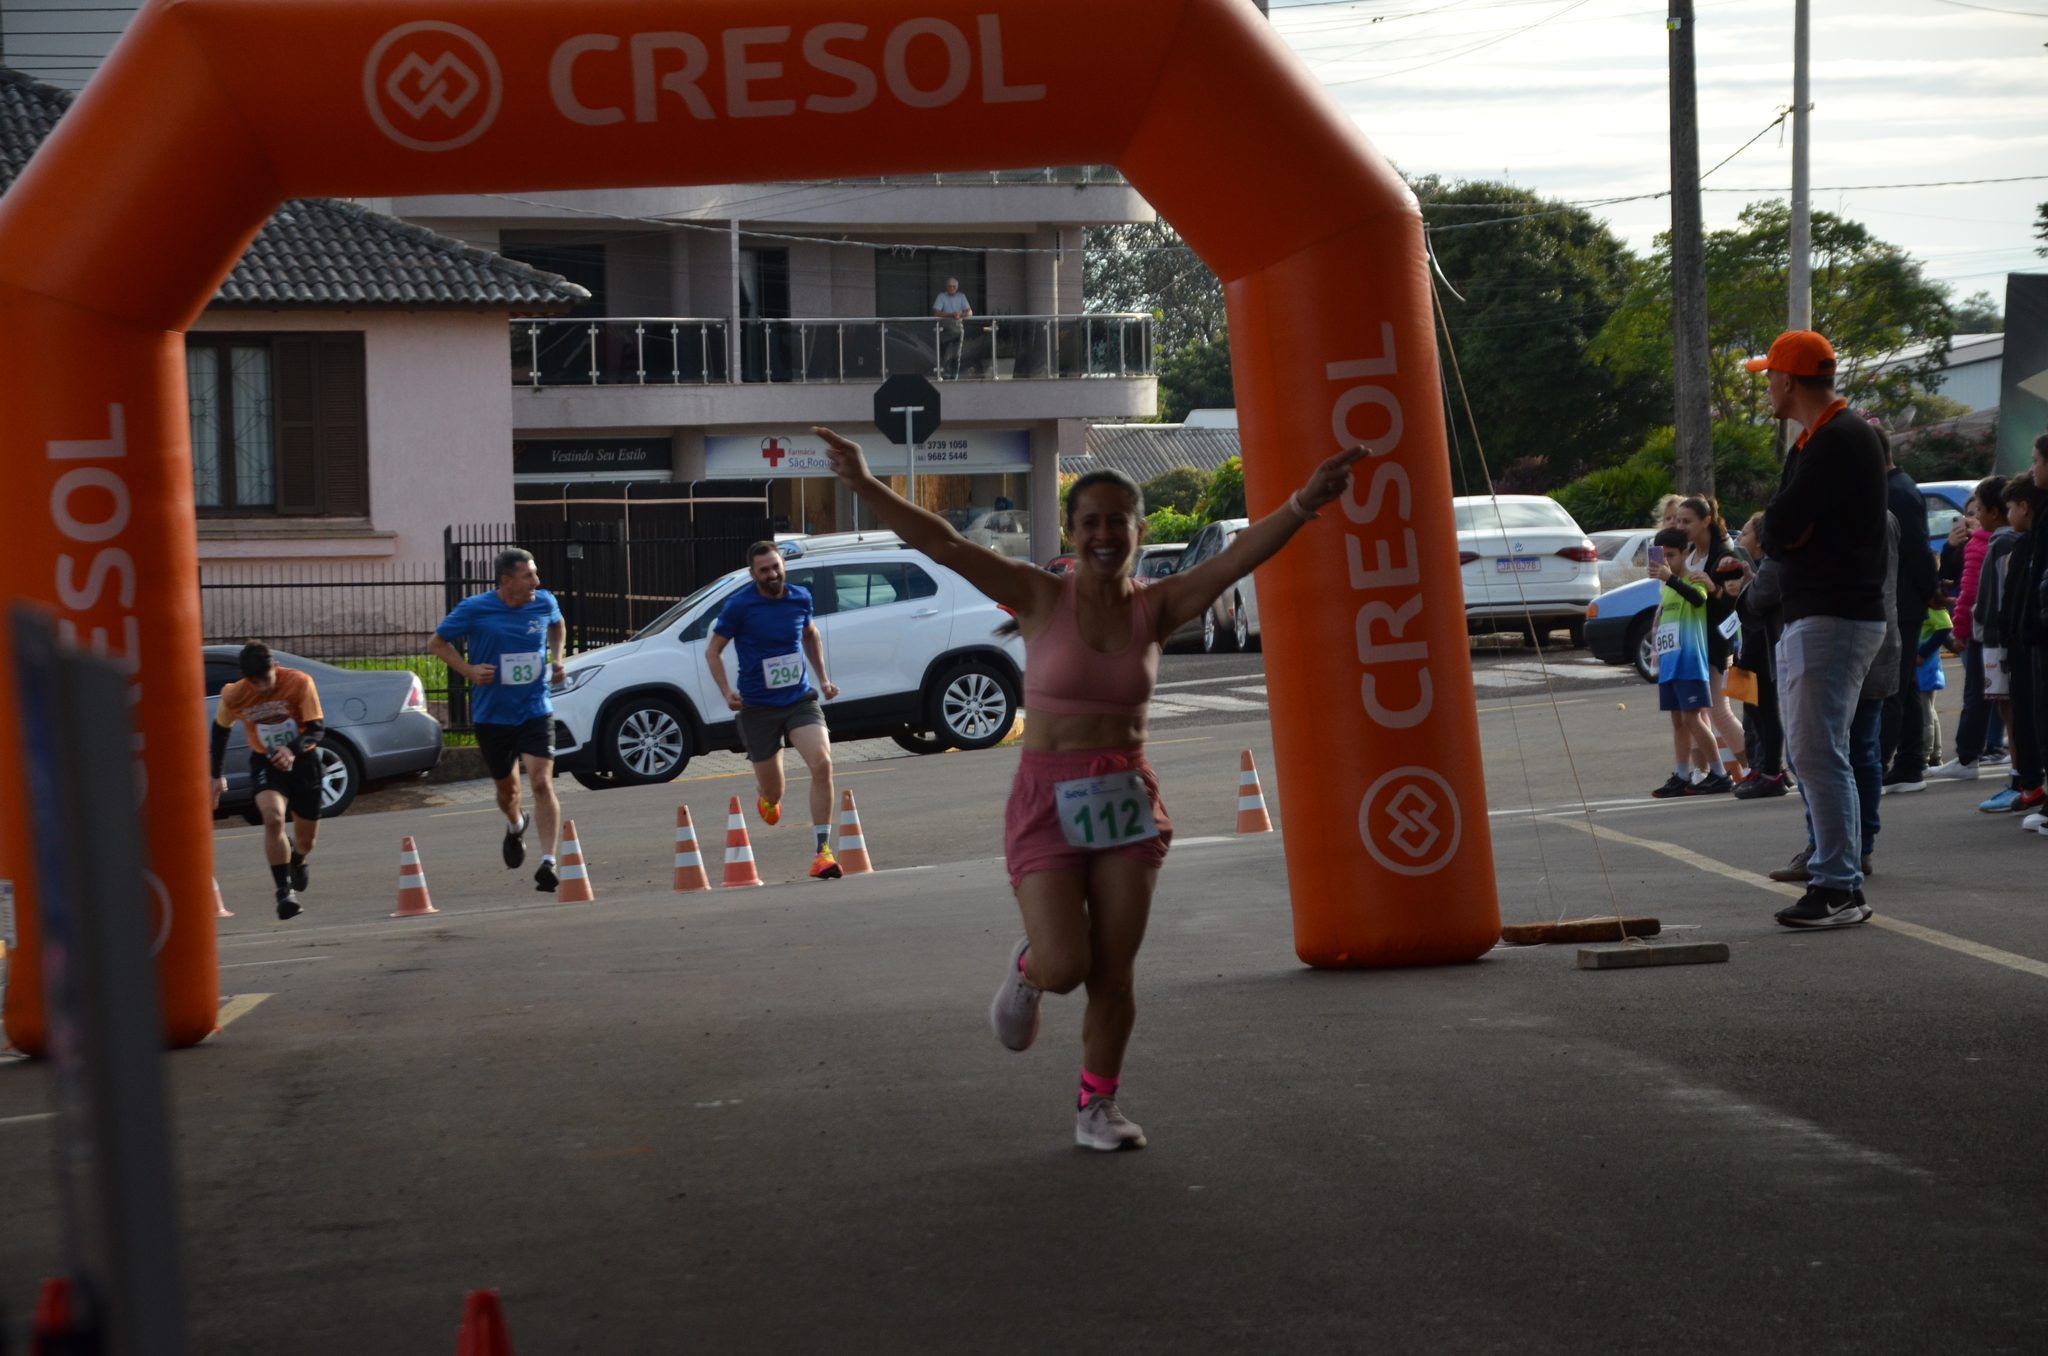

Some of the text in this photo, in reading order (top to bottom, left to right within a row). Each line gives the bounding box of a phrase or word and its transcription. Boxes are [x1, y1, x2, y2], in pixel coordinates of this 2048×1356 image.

[549, 13, 1047, 126] CRESOL
[927, 440, 947, 450] 3739
[551, 447, 647, 463] Vestindo Seu Estilo
[788, 457, 805, 468] São
[949, 451, 968, 461] 5446
[1326, 321, 1434, 729] CRESOL
[46, 402, 149, 811] ESOL
[1657, 633, 1675, 652] 968
[512, 664, 533, 682] 83
[770, 664, 800, 686] 294
[1074, 798, 1145, 843] 112
